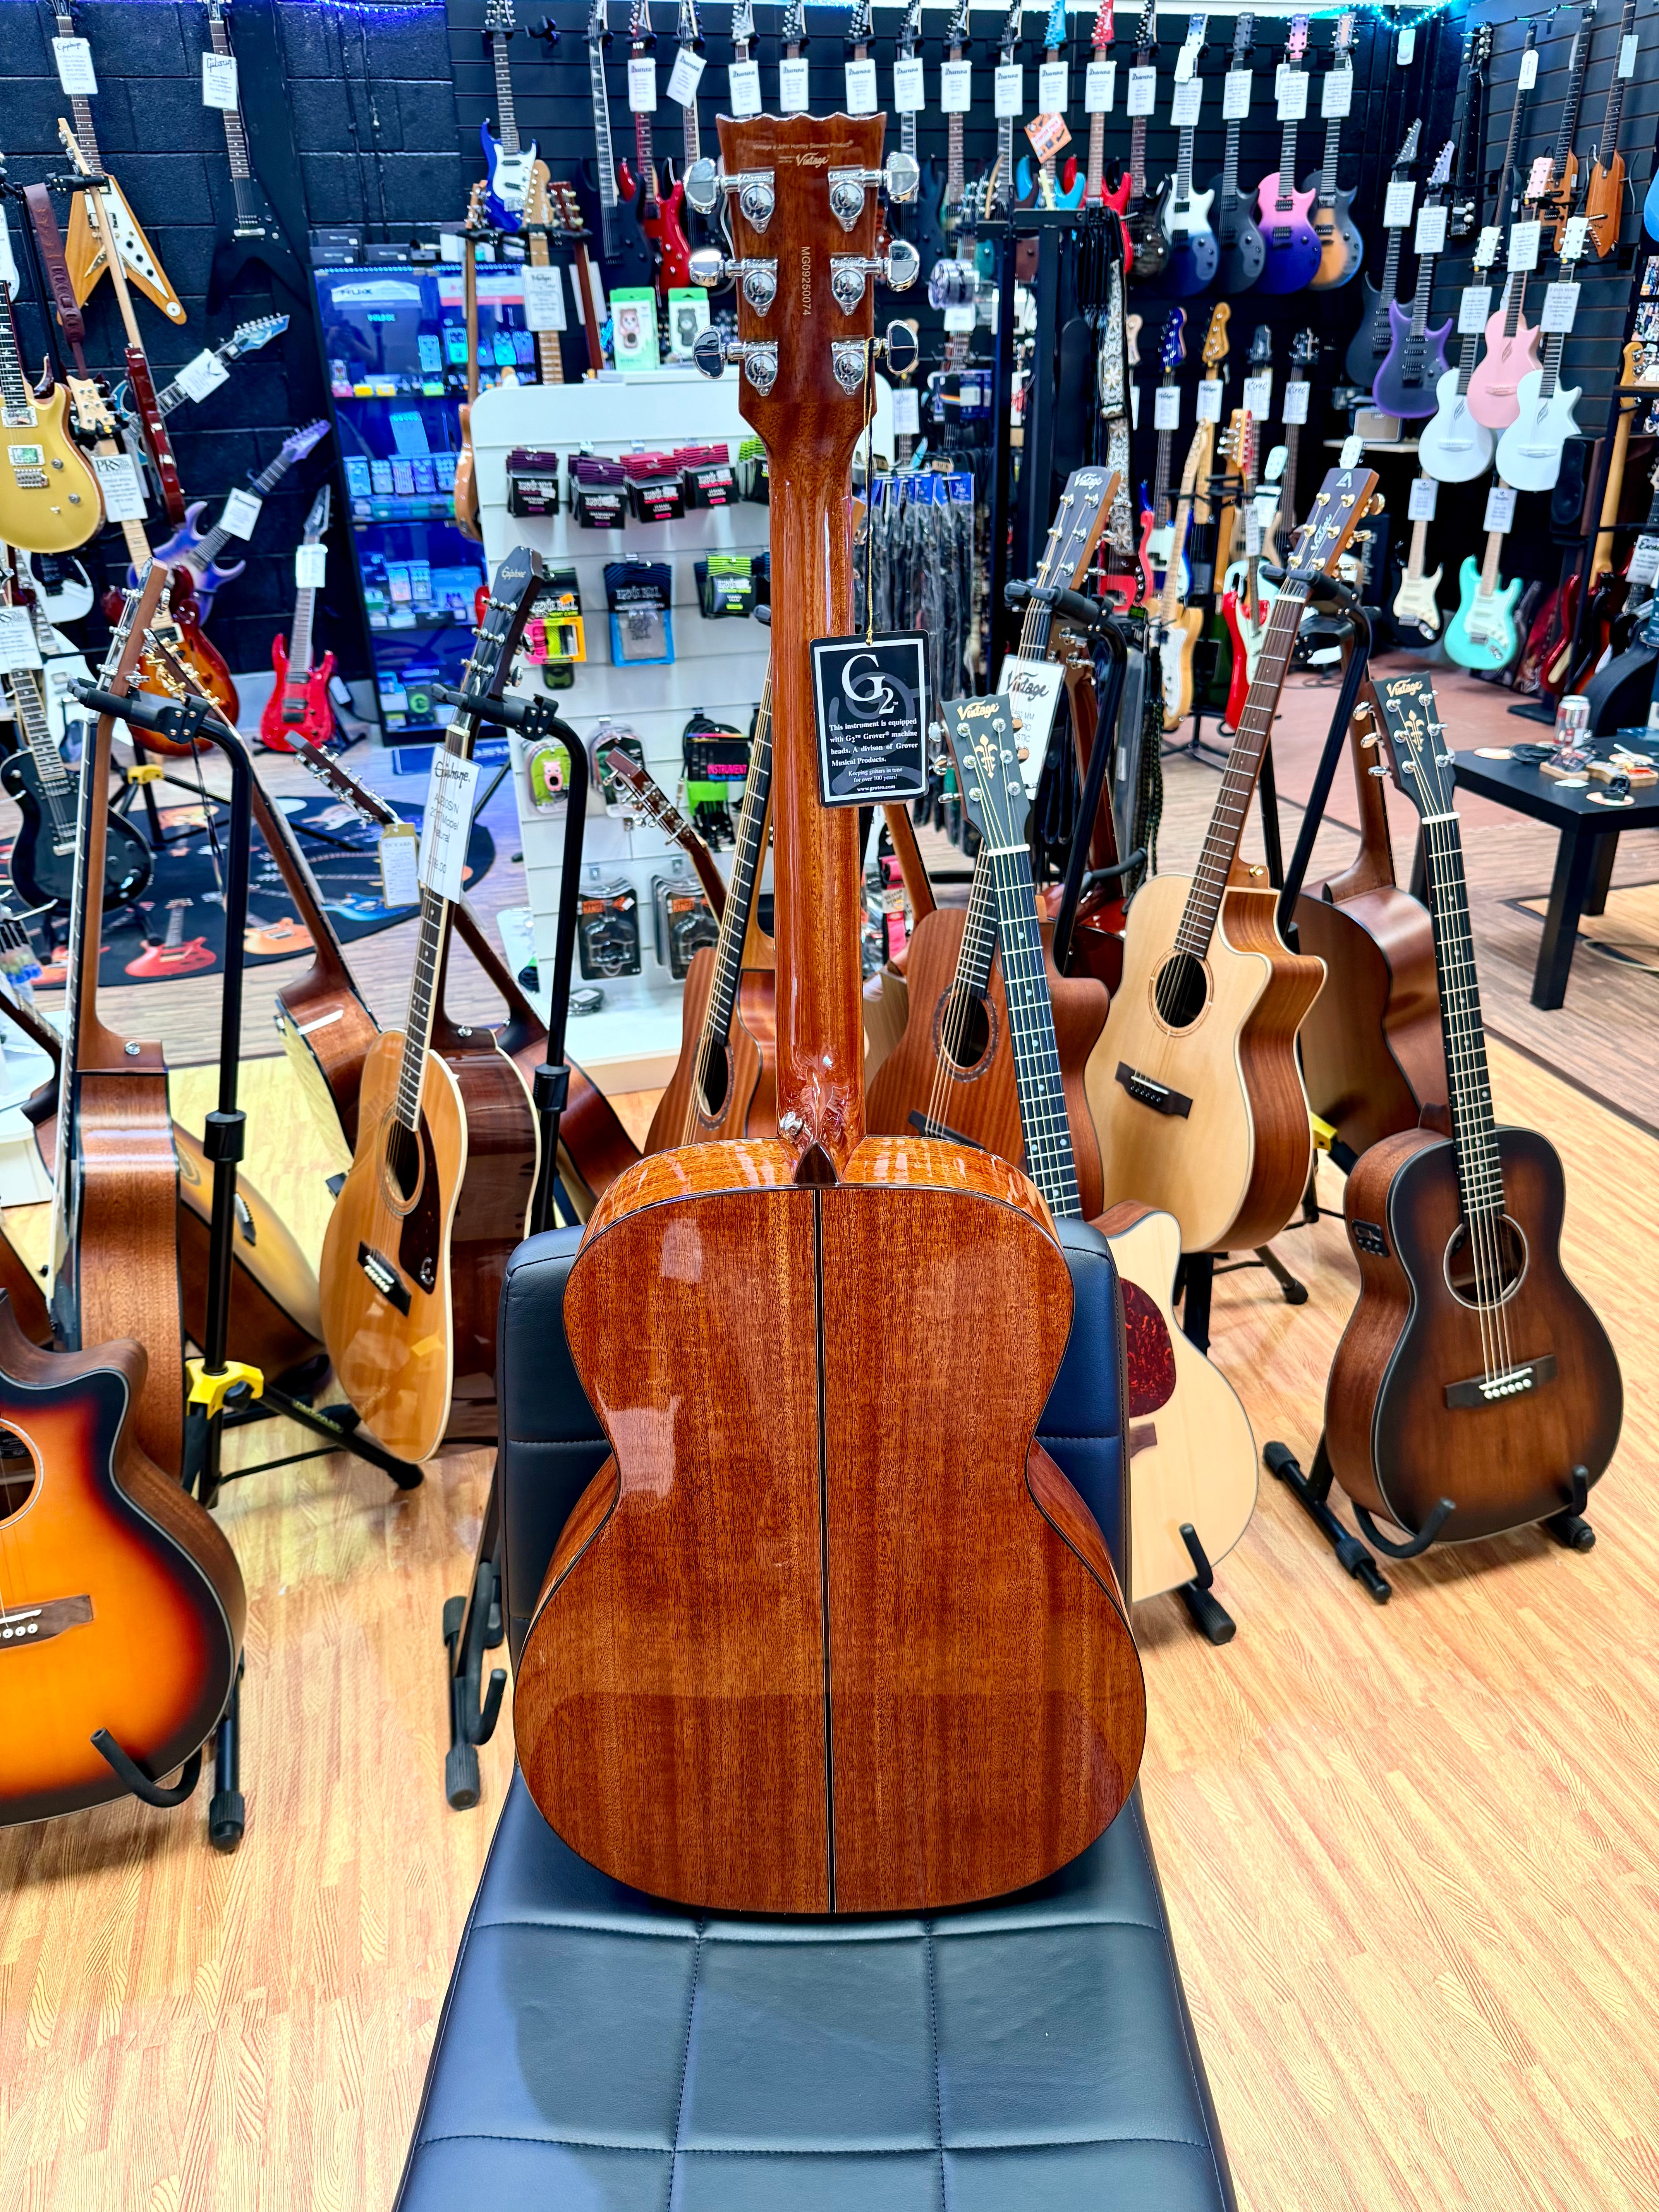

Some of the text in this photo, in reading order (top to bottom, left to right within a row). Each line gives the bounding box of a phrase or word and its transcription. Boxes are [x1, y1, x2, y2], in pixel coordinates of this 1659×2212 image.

[207, 57, 233, 73] Gibson
[796, 152, 830, 168] Vintage
[801, 246, 812, 316] MG09250074
[1074, 473, 1103, 490] Vintage
[1310, 514, 1333, 551] Vintage
[501, 566, 526, 580] Epiphone
[1006, 670, 1049, 702] Vintage
[1386, 678, 1424, 697] Vintage
[957, 700, 1000, 721] Vintage
[845, 721, 879, 730] instrument
[888, 718, 917, 727] equipped
[857, 756, 886, 764] Products.
[707, 764, 747, 775] INSTRUMENT
